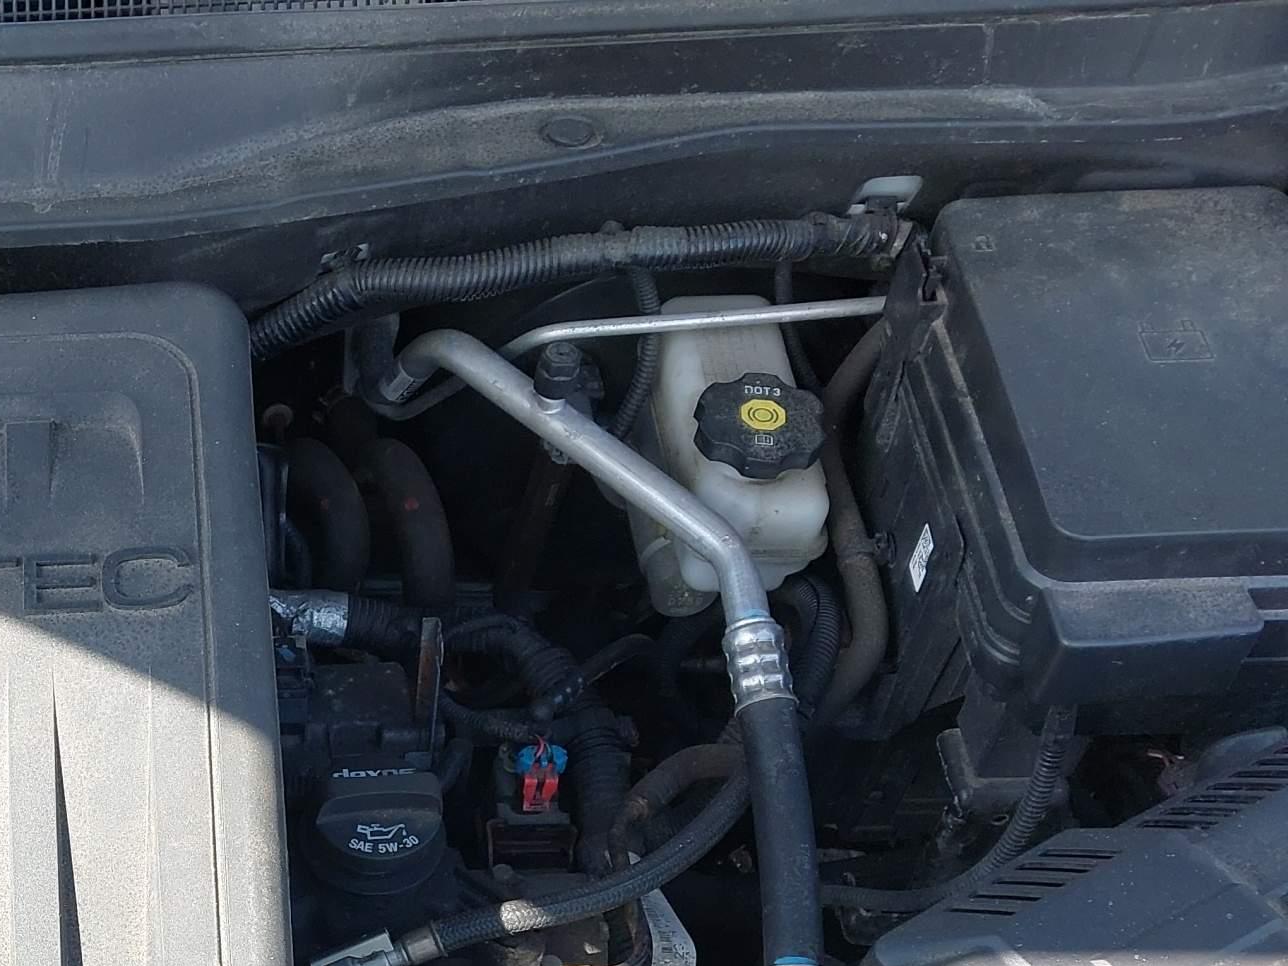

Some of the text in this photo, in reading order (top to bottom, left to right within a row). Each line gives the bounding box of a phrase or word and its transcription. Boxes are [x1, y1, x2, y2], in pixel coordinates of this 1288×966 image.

[744, 385, 782, 397] DOT 3
[348, 835, 419, 854] SAE 5W-30
